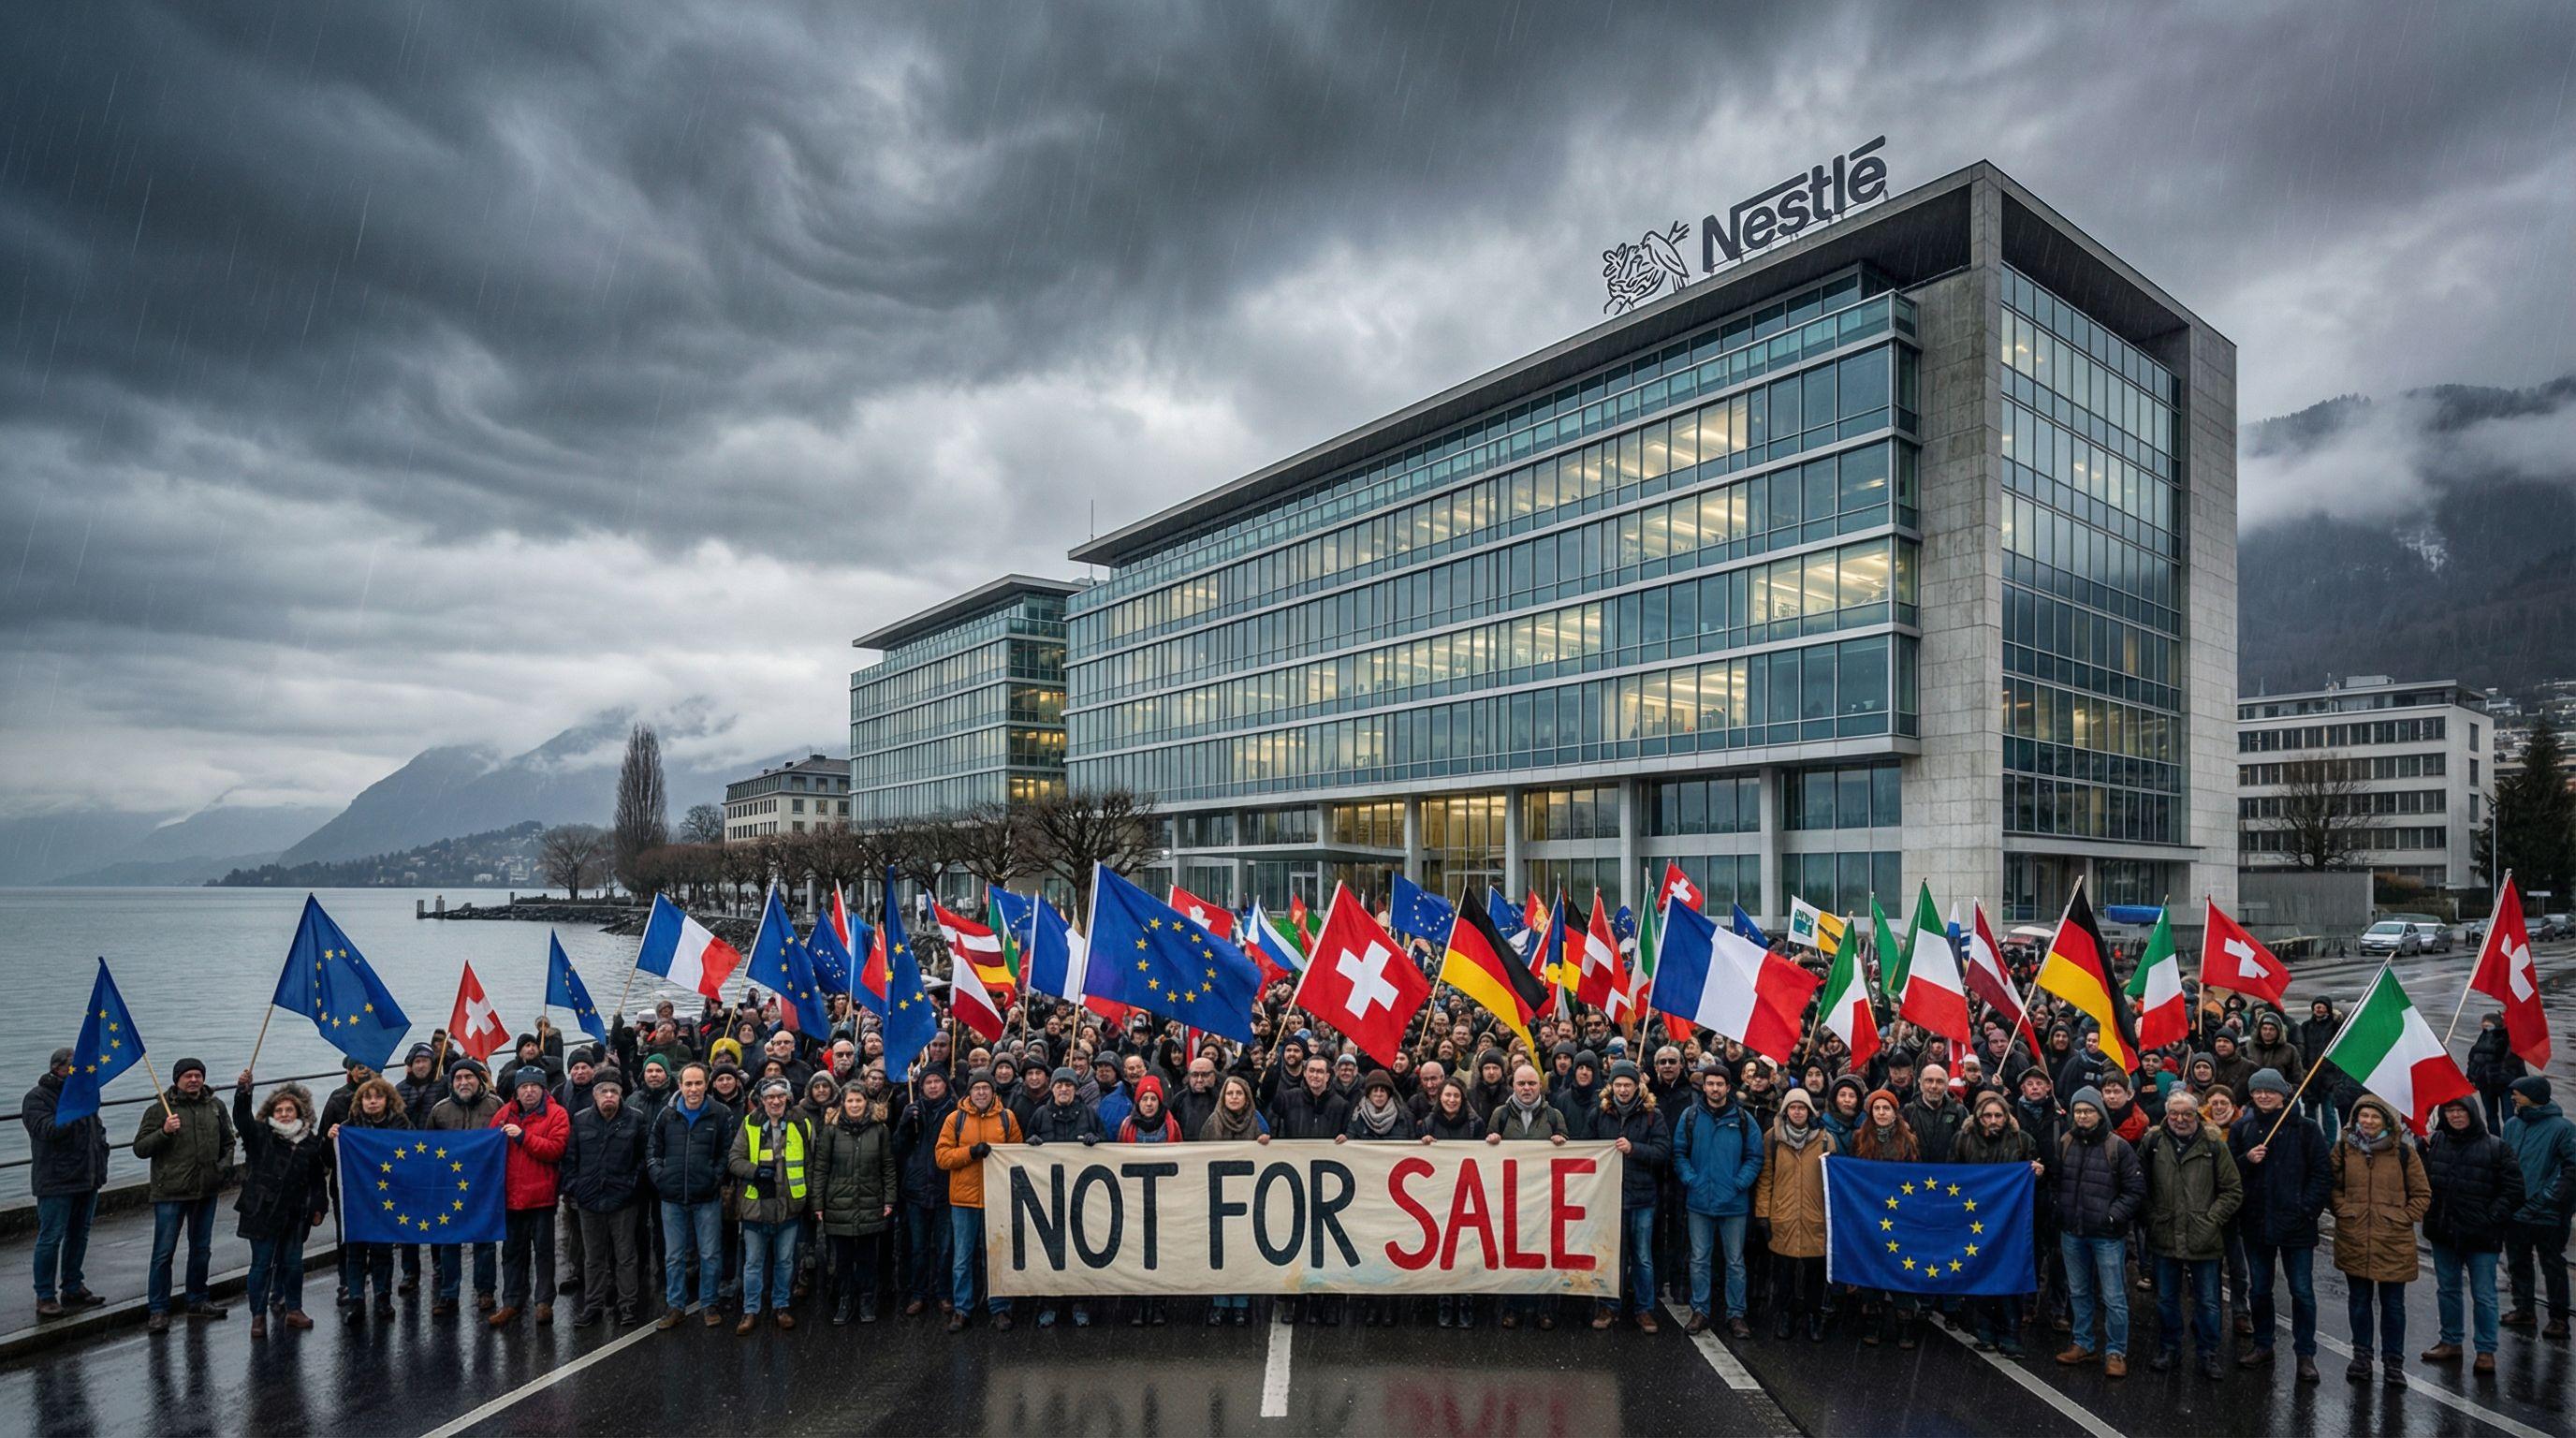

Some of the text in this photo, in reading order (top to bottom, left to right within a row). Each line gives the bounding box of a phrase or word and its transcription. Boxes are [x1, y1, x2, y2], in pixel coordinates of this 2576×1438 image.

[1702, 135, 1887, 274] Nestlé
[1009, 1156, 1597, 1271] NOT FOR SALE
